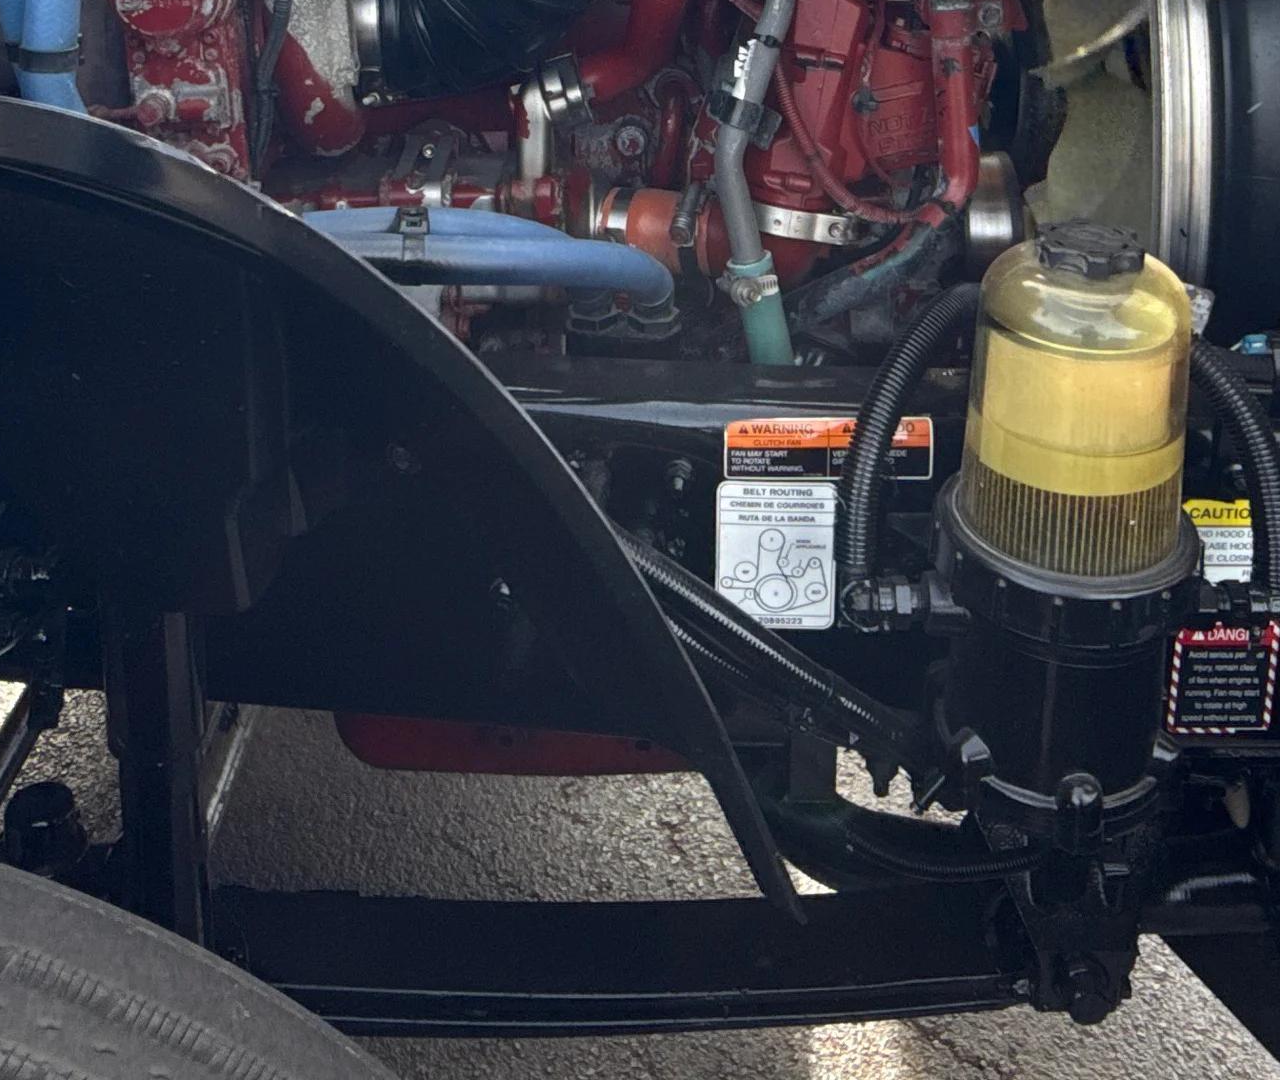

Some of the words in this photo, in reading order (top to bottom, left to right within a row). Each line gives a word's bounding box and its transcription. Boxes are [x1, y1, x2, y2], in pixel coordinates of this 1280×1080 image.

[751, 423, 814, 434] WARNING
[753, 439, 785, 447] CLUTCH
[786, 439, 802, 447] FAN
[742, 487, 767, 496] BELT
[769, 488, 814, 497] ROUTING
[763, 501, 775, 509] DE
[1189, 507, 1251, 520] CAUTIO
[787, 515, 816, 523] BANDA
[1215, 530, 1245, 538] HOOD
[1207, 628, 1250, 641] DANG
[1188, 651, 1208, 659] Avoid
[1209, 651, 1233, 659] serious
[1239, 664, 1258, 672] clear
